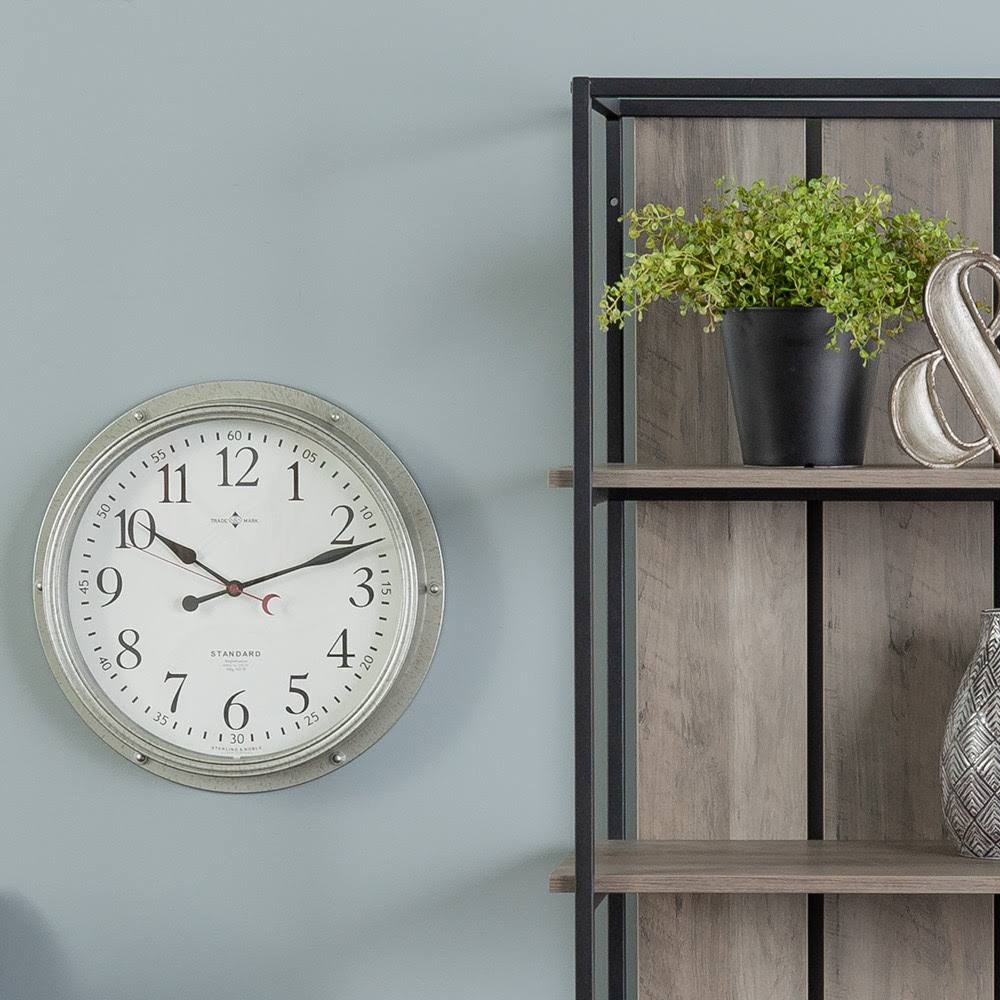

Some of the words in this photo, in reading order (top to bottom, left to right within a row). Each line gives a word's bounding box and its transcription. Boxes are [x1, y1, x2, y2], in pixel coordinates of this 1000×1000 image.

[227, 430, 242, 441] 60
[150, 448, 167, 464] 55
[301, 448, 319, 464] 05
[215, 446, 260, 487] 12
[156, 462, 192, 503] 11
[287, 460, 305, 501] 1
[96, 503, 111, 520] 50
[358, 503, 374, 521] 10
[113, 508, 156, 549] 10
[329, 504, 355, 545] 2
[78, 579, 90, 595] 45
[96, 566, 123, 607] 9
[348, 566, 375, 607] 3
[381, 580, 392, 596] 15
[115, 628, 142, 669] 8
[210, 650, 261, 658] STANDARD
[326, 628, 356, 669] 4
[98, 655, 113, 672] 40
[359, 654, 374, 672] 20
[163, 671, 188, 714] 7
[285, 672, 310, 714] 5
[152, 711, 169, 726] 35
[223, 690, 250, 731] 6
[303, 711, 320, 727] 25
[230, 733, 245, 745] 30
